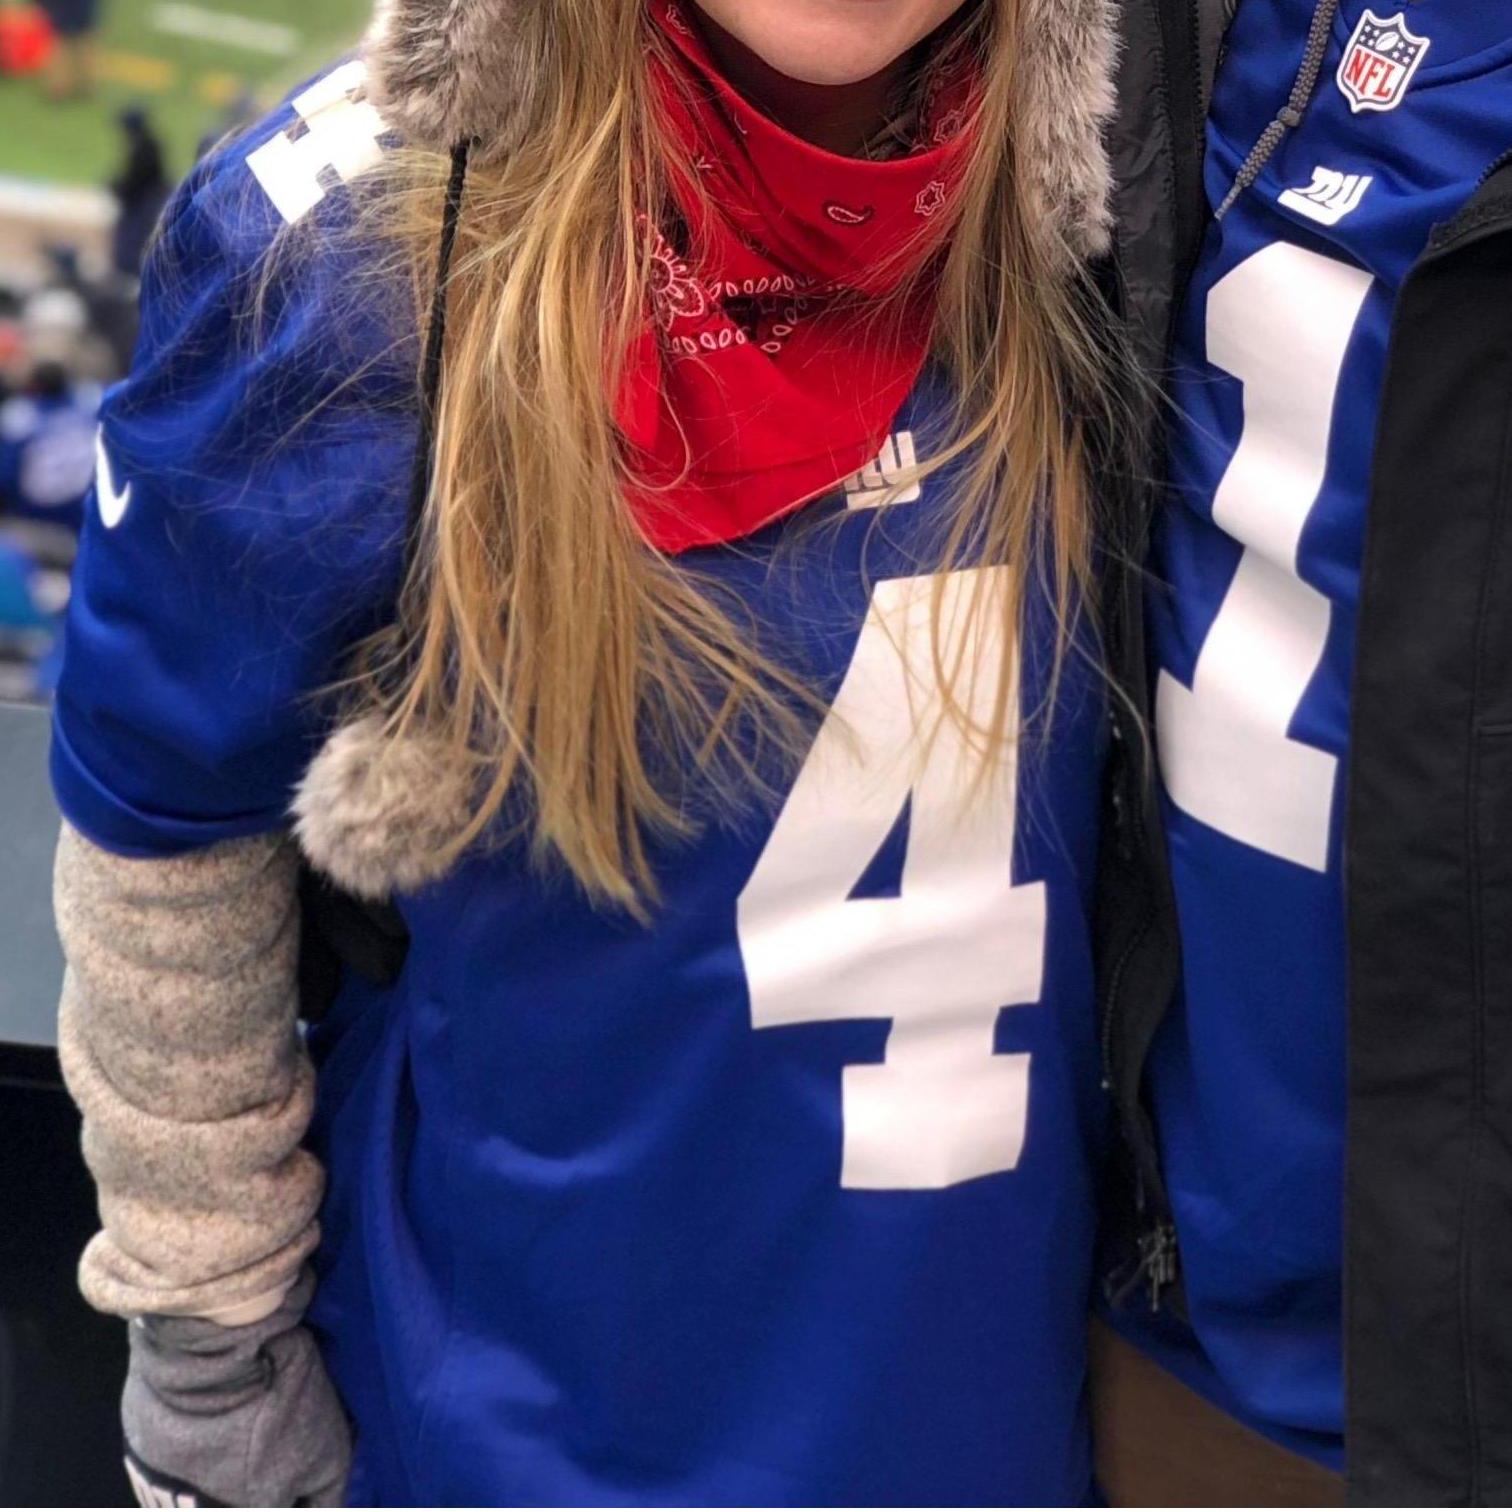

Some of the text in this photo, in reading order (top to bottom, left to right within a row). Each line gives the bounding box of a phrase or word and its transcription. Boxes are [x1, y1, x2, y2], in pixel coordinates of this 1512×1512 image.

[1345, 48, 1396, 98] NFL
[1157, 241, 1374, 873] 1
[738, 564, 1047, 1190] 4
